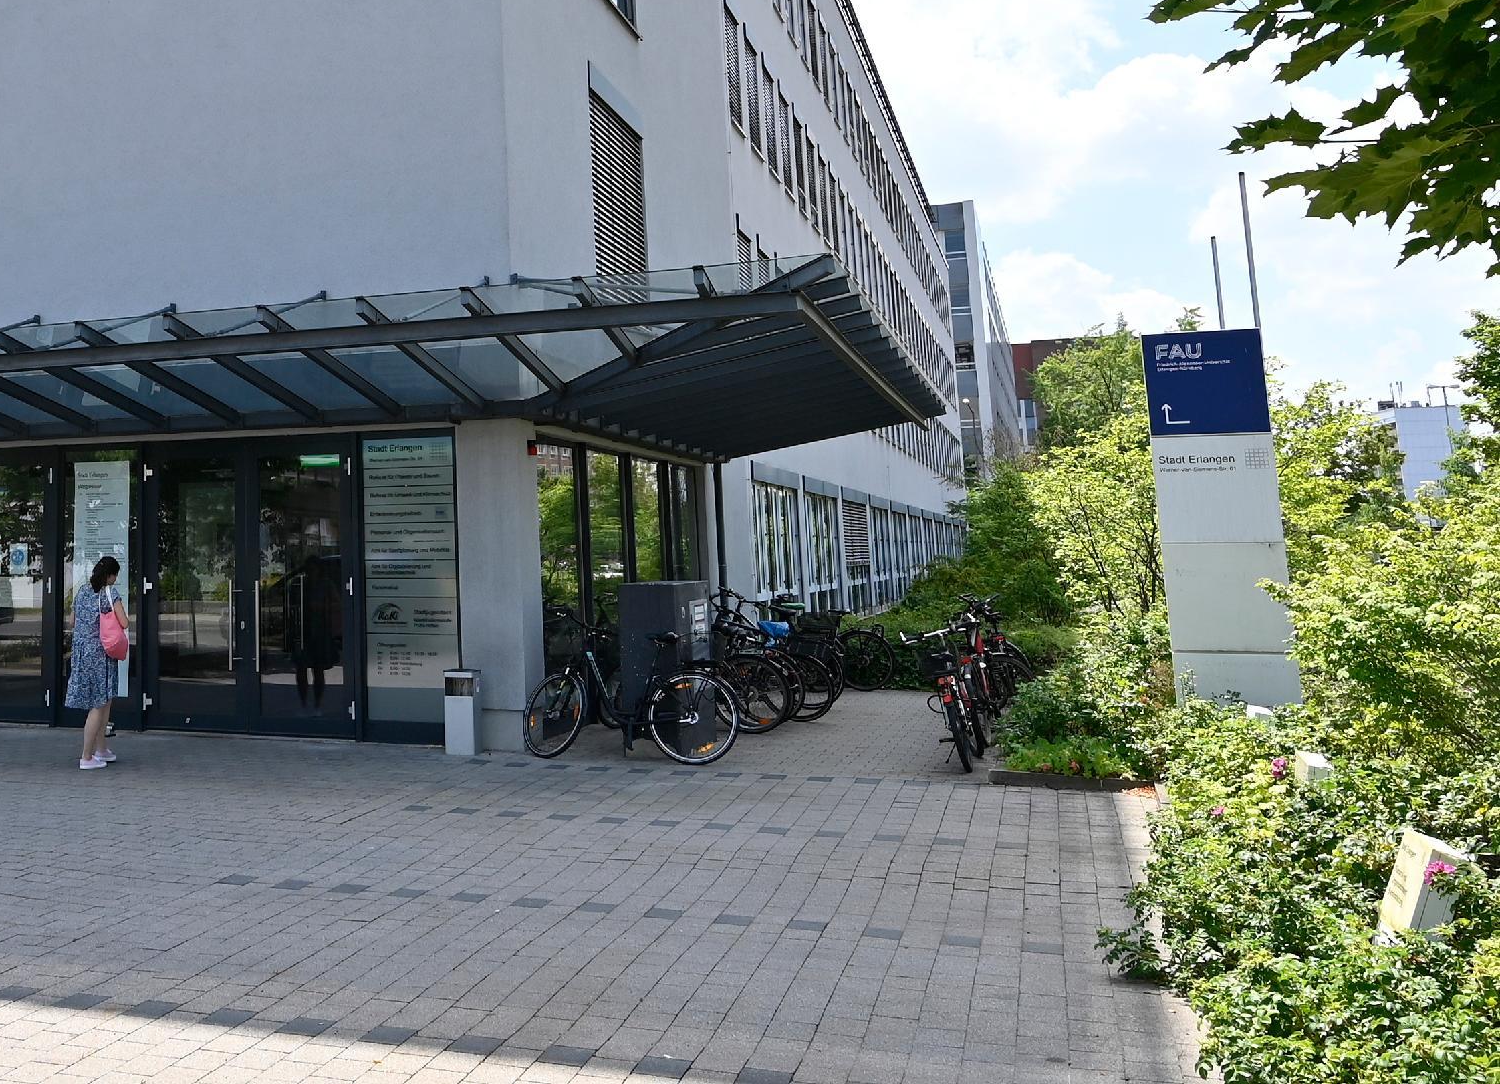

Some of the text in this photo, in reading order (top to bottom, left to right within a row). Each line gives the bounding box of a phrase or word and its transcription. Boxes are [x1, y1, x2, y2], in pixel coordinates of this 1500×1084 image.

[1155, 342, 1202, 360] FAU
[389, 444, 423, 453] Erlangen
[1158, 455, 1236, 465] Stadt Erlangen
